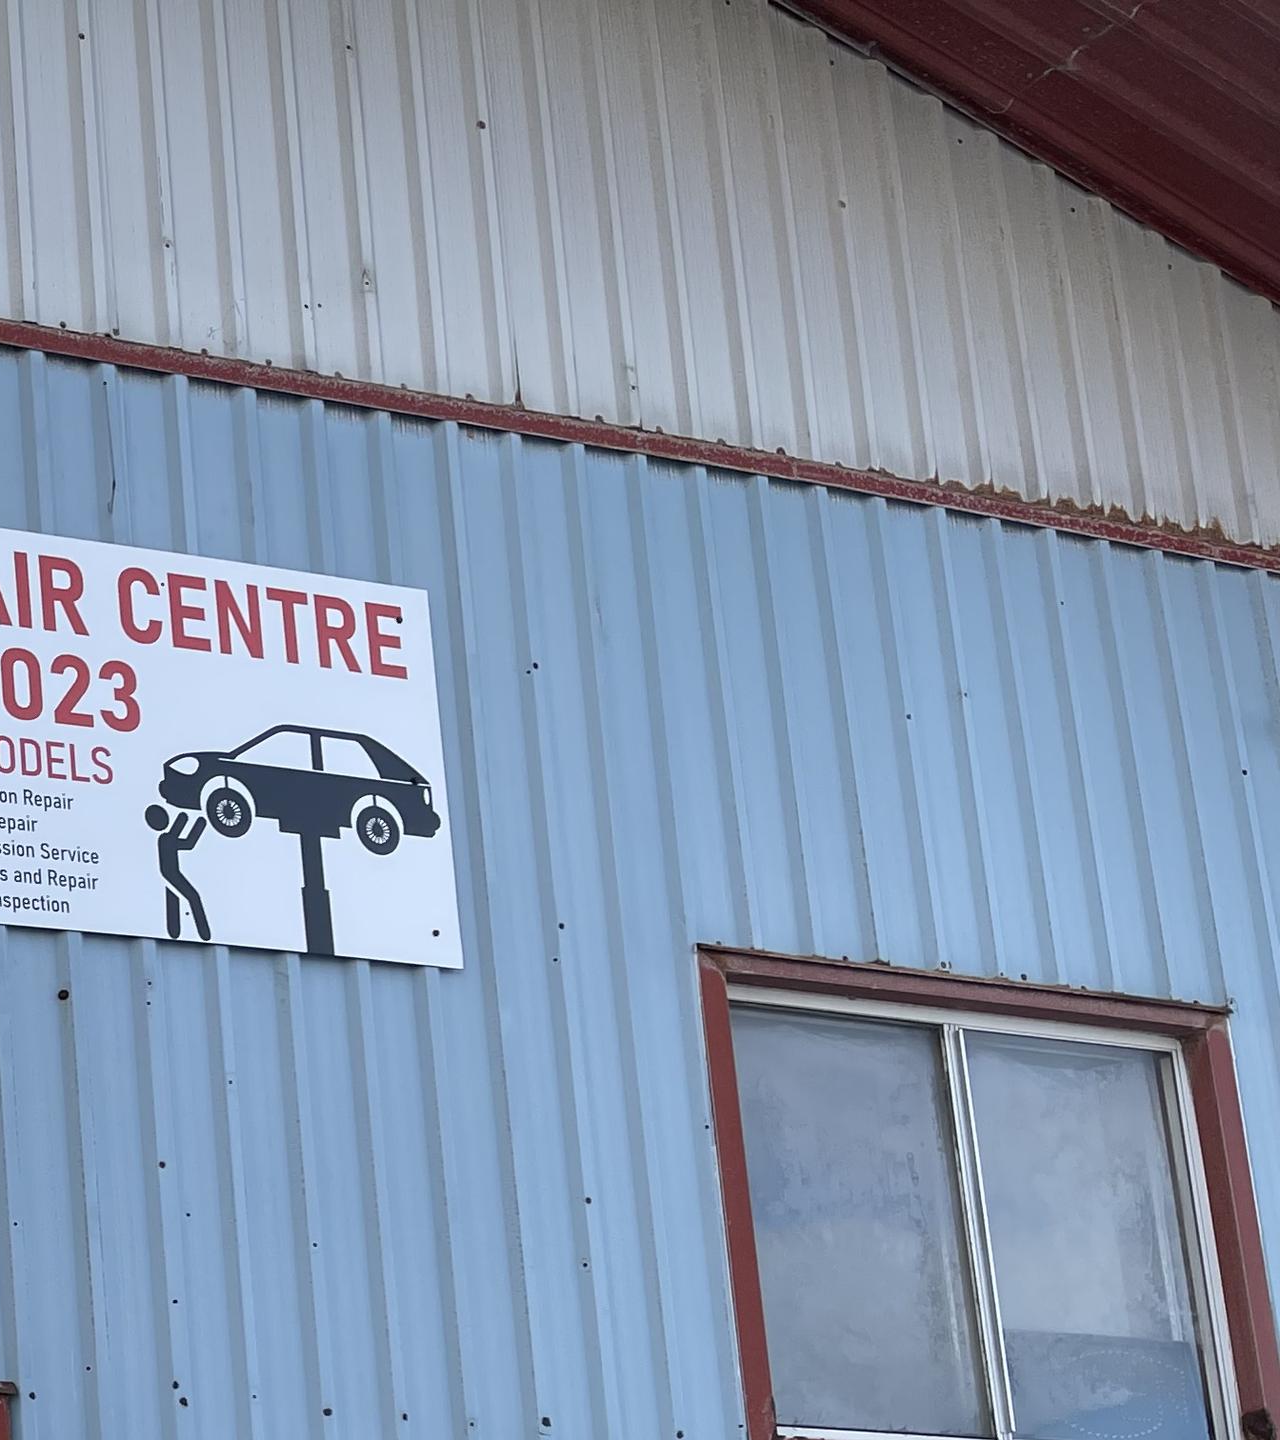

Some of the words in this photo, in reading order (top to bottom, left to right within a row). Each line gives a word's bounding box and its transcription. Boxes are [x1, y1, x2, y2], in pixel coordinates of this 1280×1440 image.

[117, 566, 409, 680] CENTRE
[23, 789, 74, 811] Repair
[40, 843, 99, 864] Service
[14, 868, 41, 885] and
[48, 869, 99, 892] Repair
